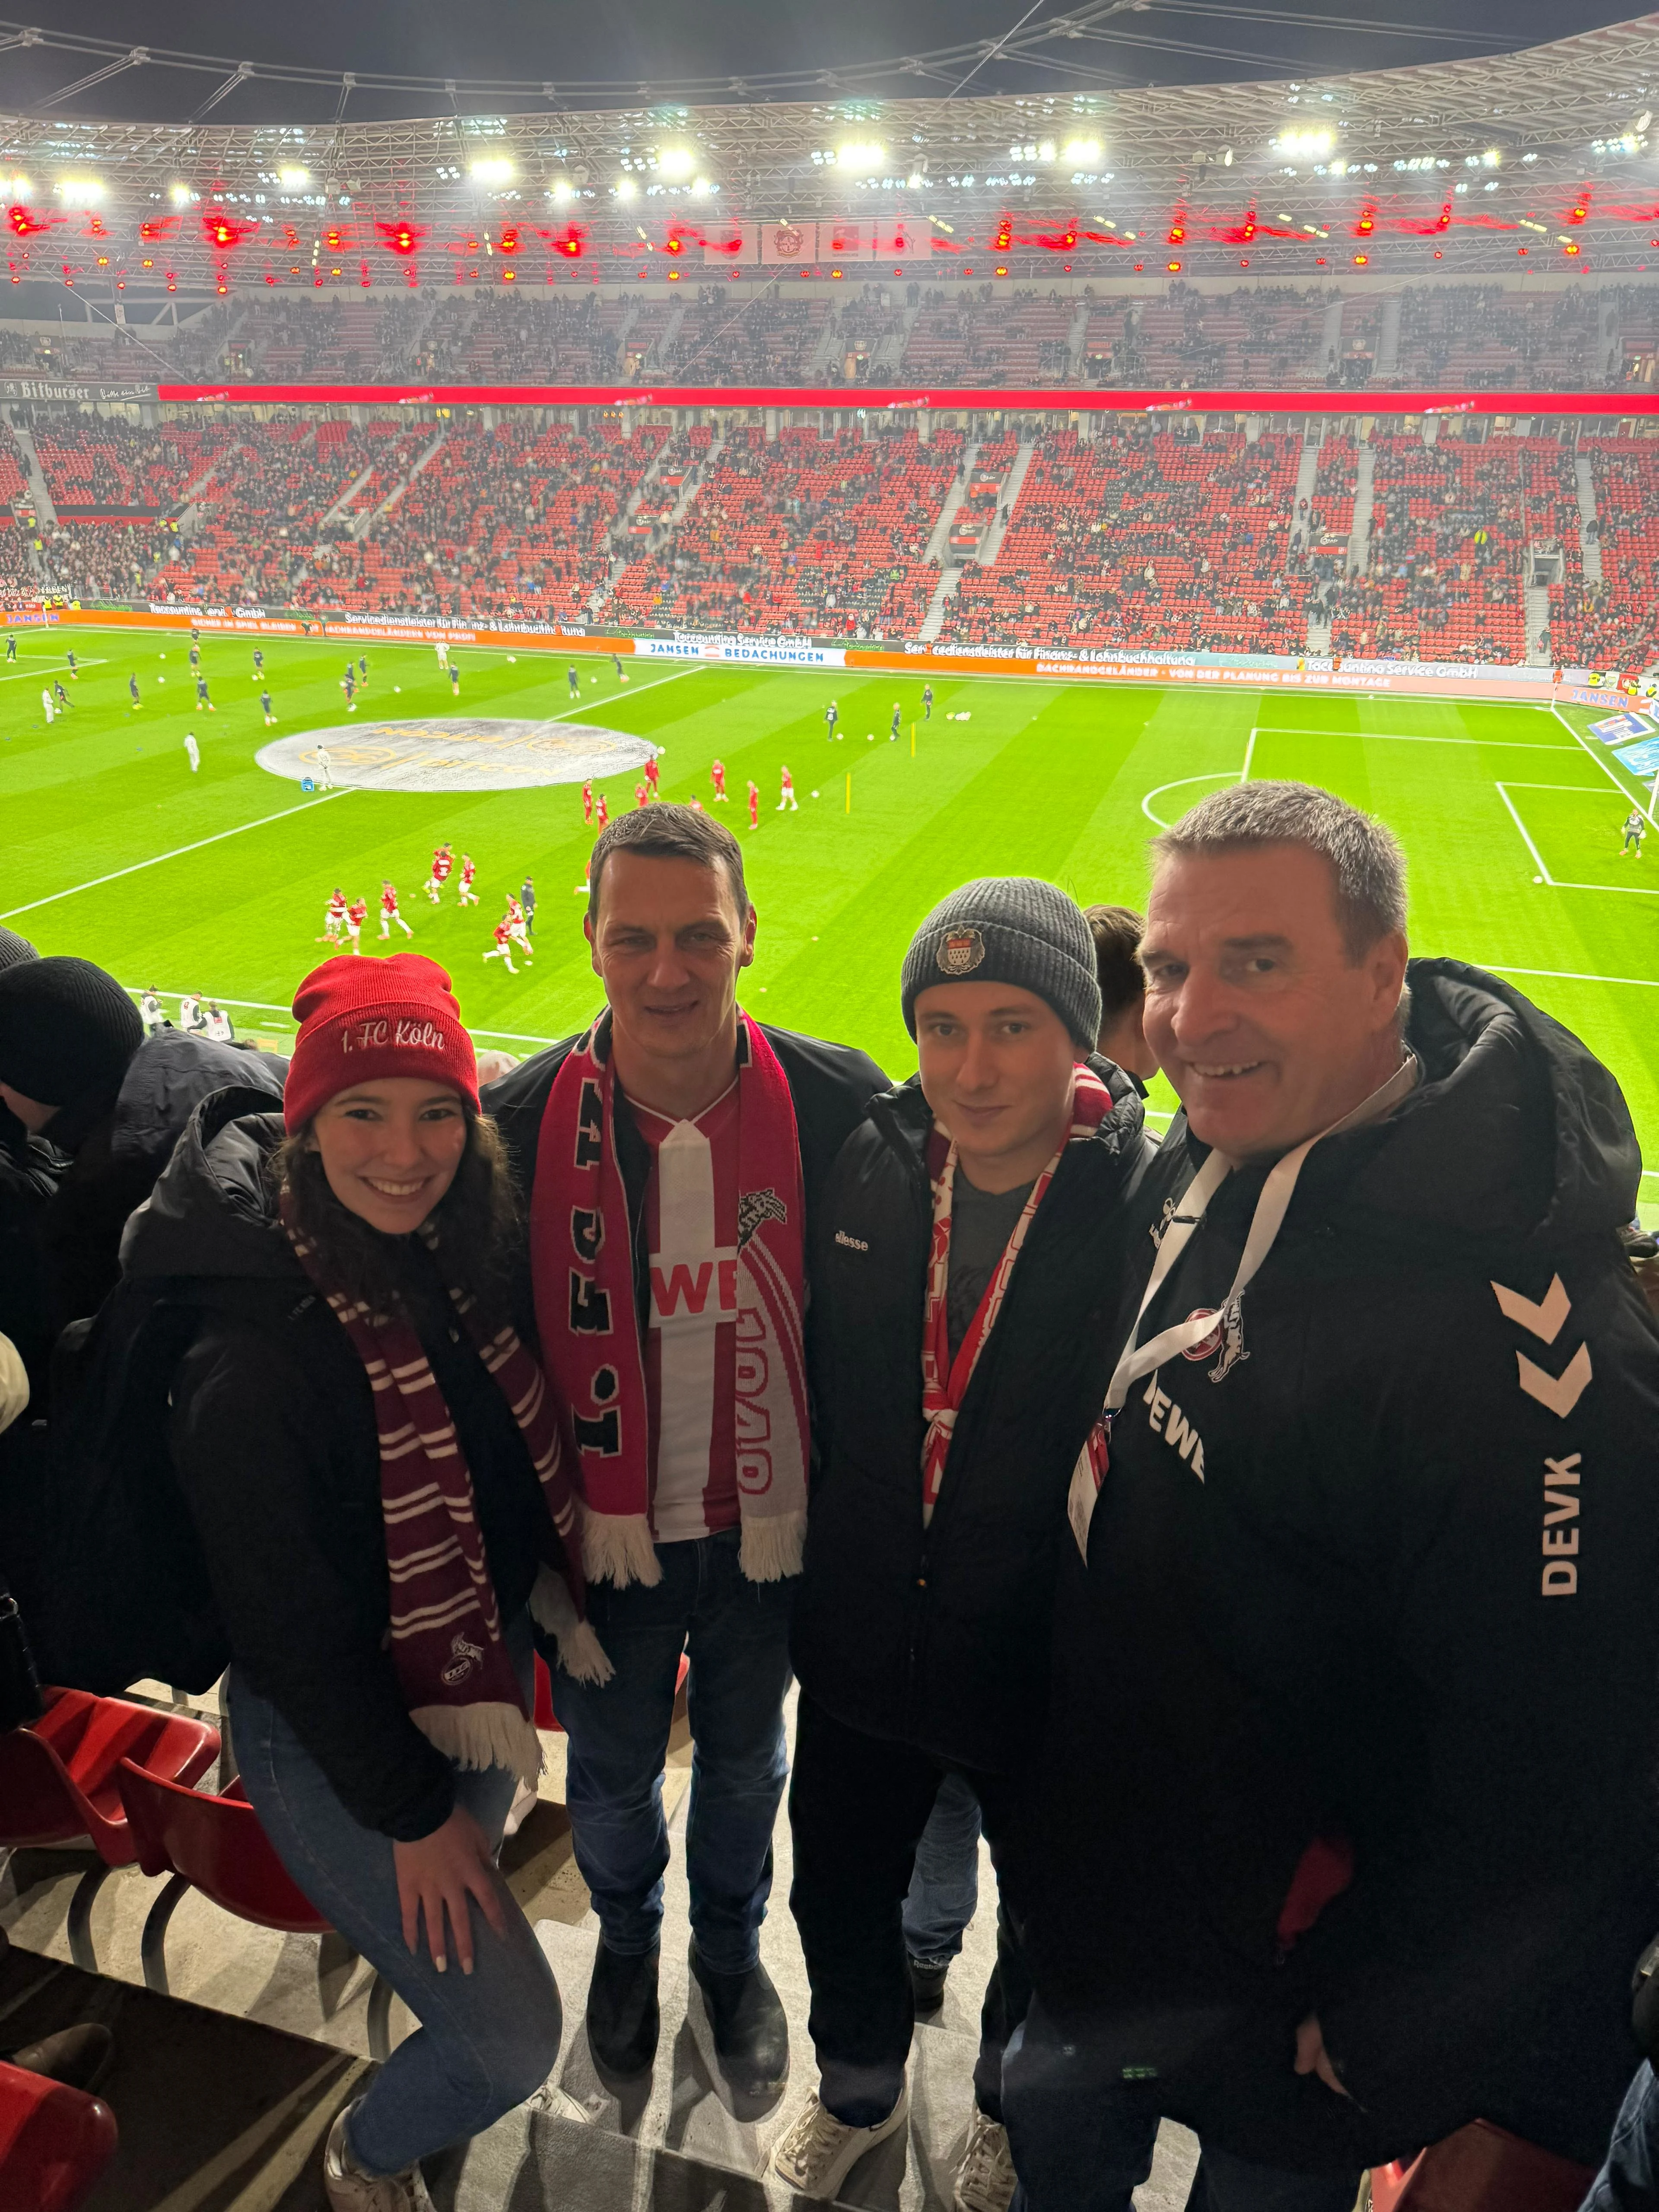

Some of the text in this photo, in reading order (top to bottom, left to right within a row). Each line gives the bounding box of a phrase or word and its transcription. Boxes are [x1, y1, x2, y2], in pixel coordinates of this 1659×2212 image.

[21, 381, 89, 399] Bitburger
[651, 643, 823, 662] JANSEN BEDACHUNGEN
[1571, 689, 1628, 708] JANSEN
[341, 1019, 445, 1053] 1. FC Köln
[1541, 1452, 1581, 1596] DEVK
[913, 1959, 940, 1970] Reebo
